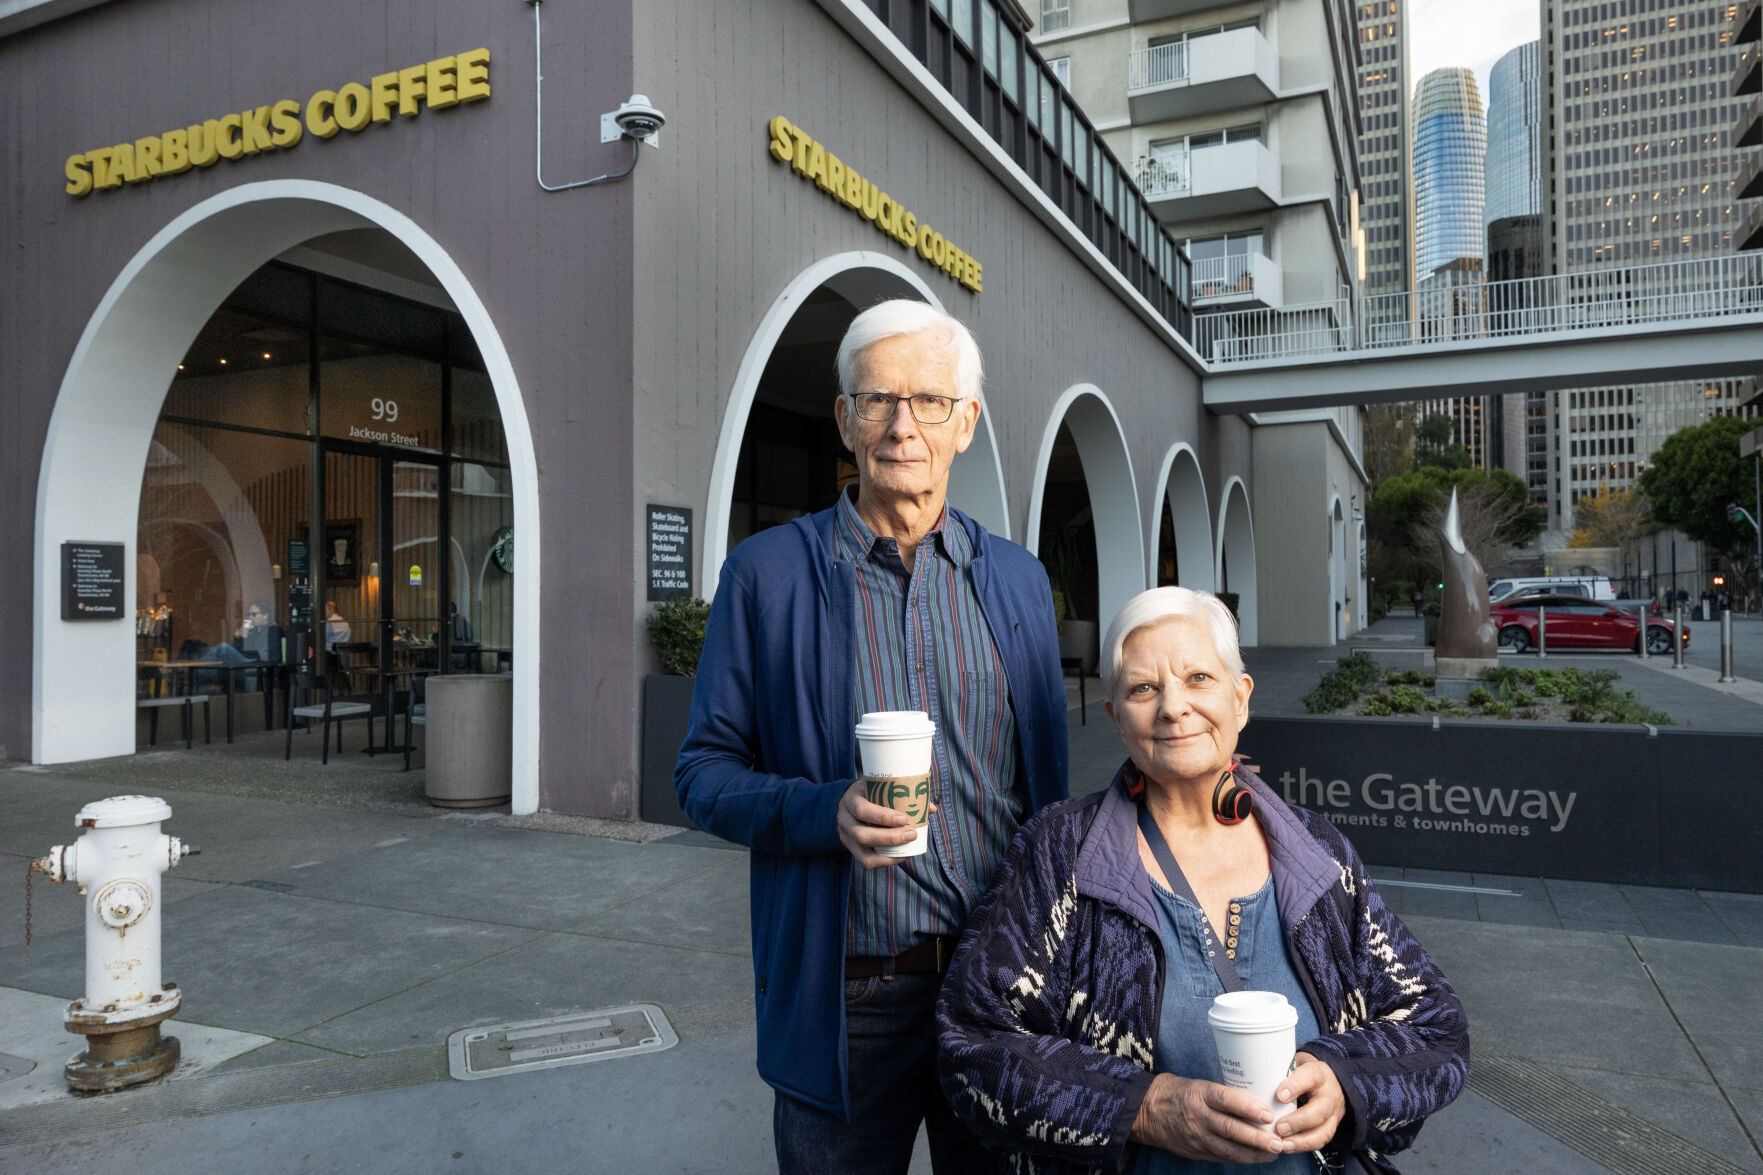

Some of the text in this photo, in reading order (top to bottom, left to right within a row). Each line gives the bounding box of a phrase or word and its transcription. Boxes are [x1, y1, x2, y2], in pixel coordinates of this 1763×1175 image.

[65, 48, 490, 196] STARBUCKS COFFEE
[770, 115, 983, 293] STARBUCKS COFFEE
[371, 398, 398, 422] 99
[349, 425, 418, 446] Jackson Street
[652, 511, 666, 520] Roller
[652, 522, 689, 533] Skateboard and
[652, 532, 684, 544] Bicycle Riding
[652, 542, 677, 552] Prohibited
[652, 553, 684, 562] On Sidewalks
[652, 569, 663, 577] SEC.
[676, 570, 686, 578] 100
[661, 580, 676, 588] Traffic
[1279, 767, 1577, 832] the Gateway
[1393, 815, 1406, 828] &
[1412, 816, 1530, 836] townhomes
